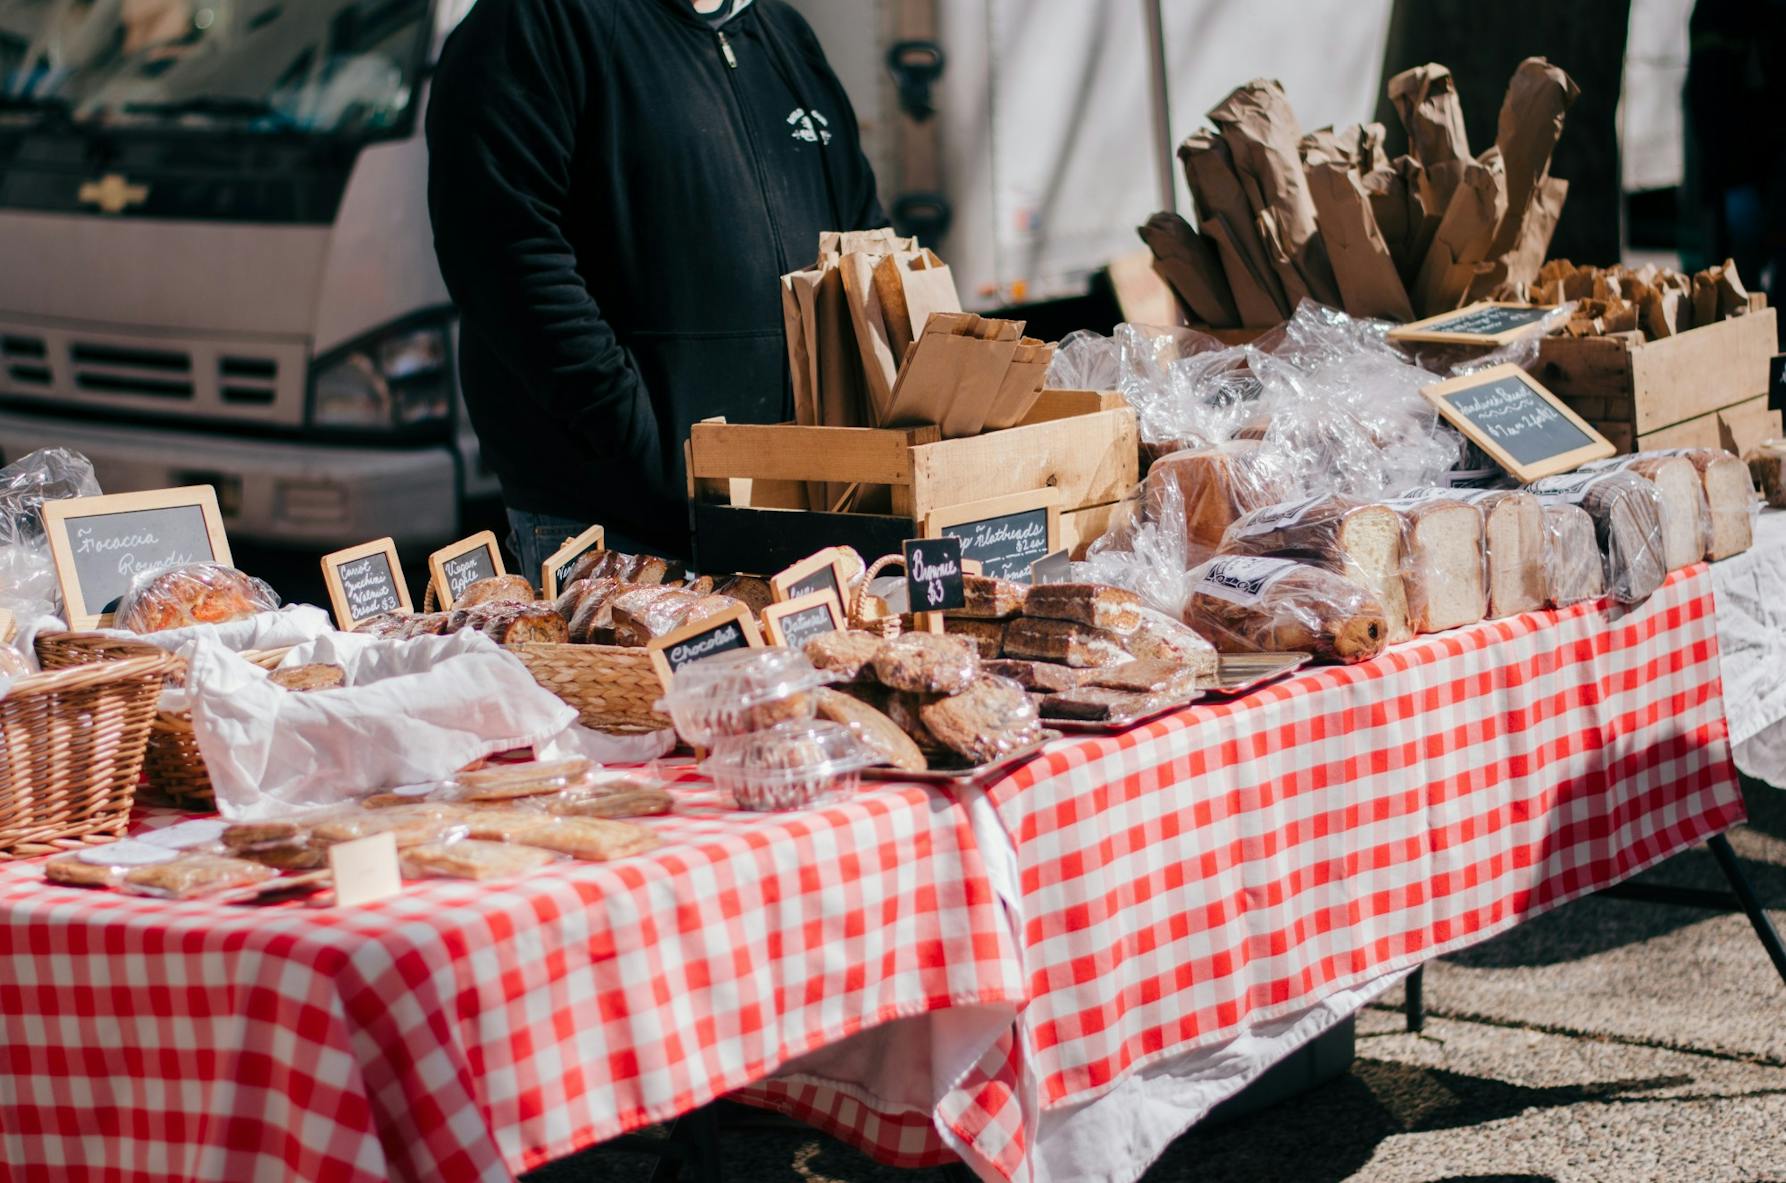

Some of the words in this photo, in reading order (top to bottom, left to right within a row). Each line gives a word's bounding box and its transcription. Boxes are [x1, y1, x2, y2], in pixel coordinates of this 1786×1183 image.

[77, 528, 160, 553] Focaccia
[974, 522, 1044, 548] Flatbreads
[118, 551, 192, 576] Rounds
[341, 560, 371, 580] Carrot
[445, 559, 477, 579] Vegan
[912, 549, 957, 582] Brownie
[353, 586, 389, 603] Walnut
[927, 579, 944, 606] $3
[351, 599, 380, 619] Bread
[381, 597, 396, 610] $3
